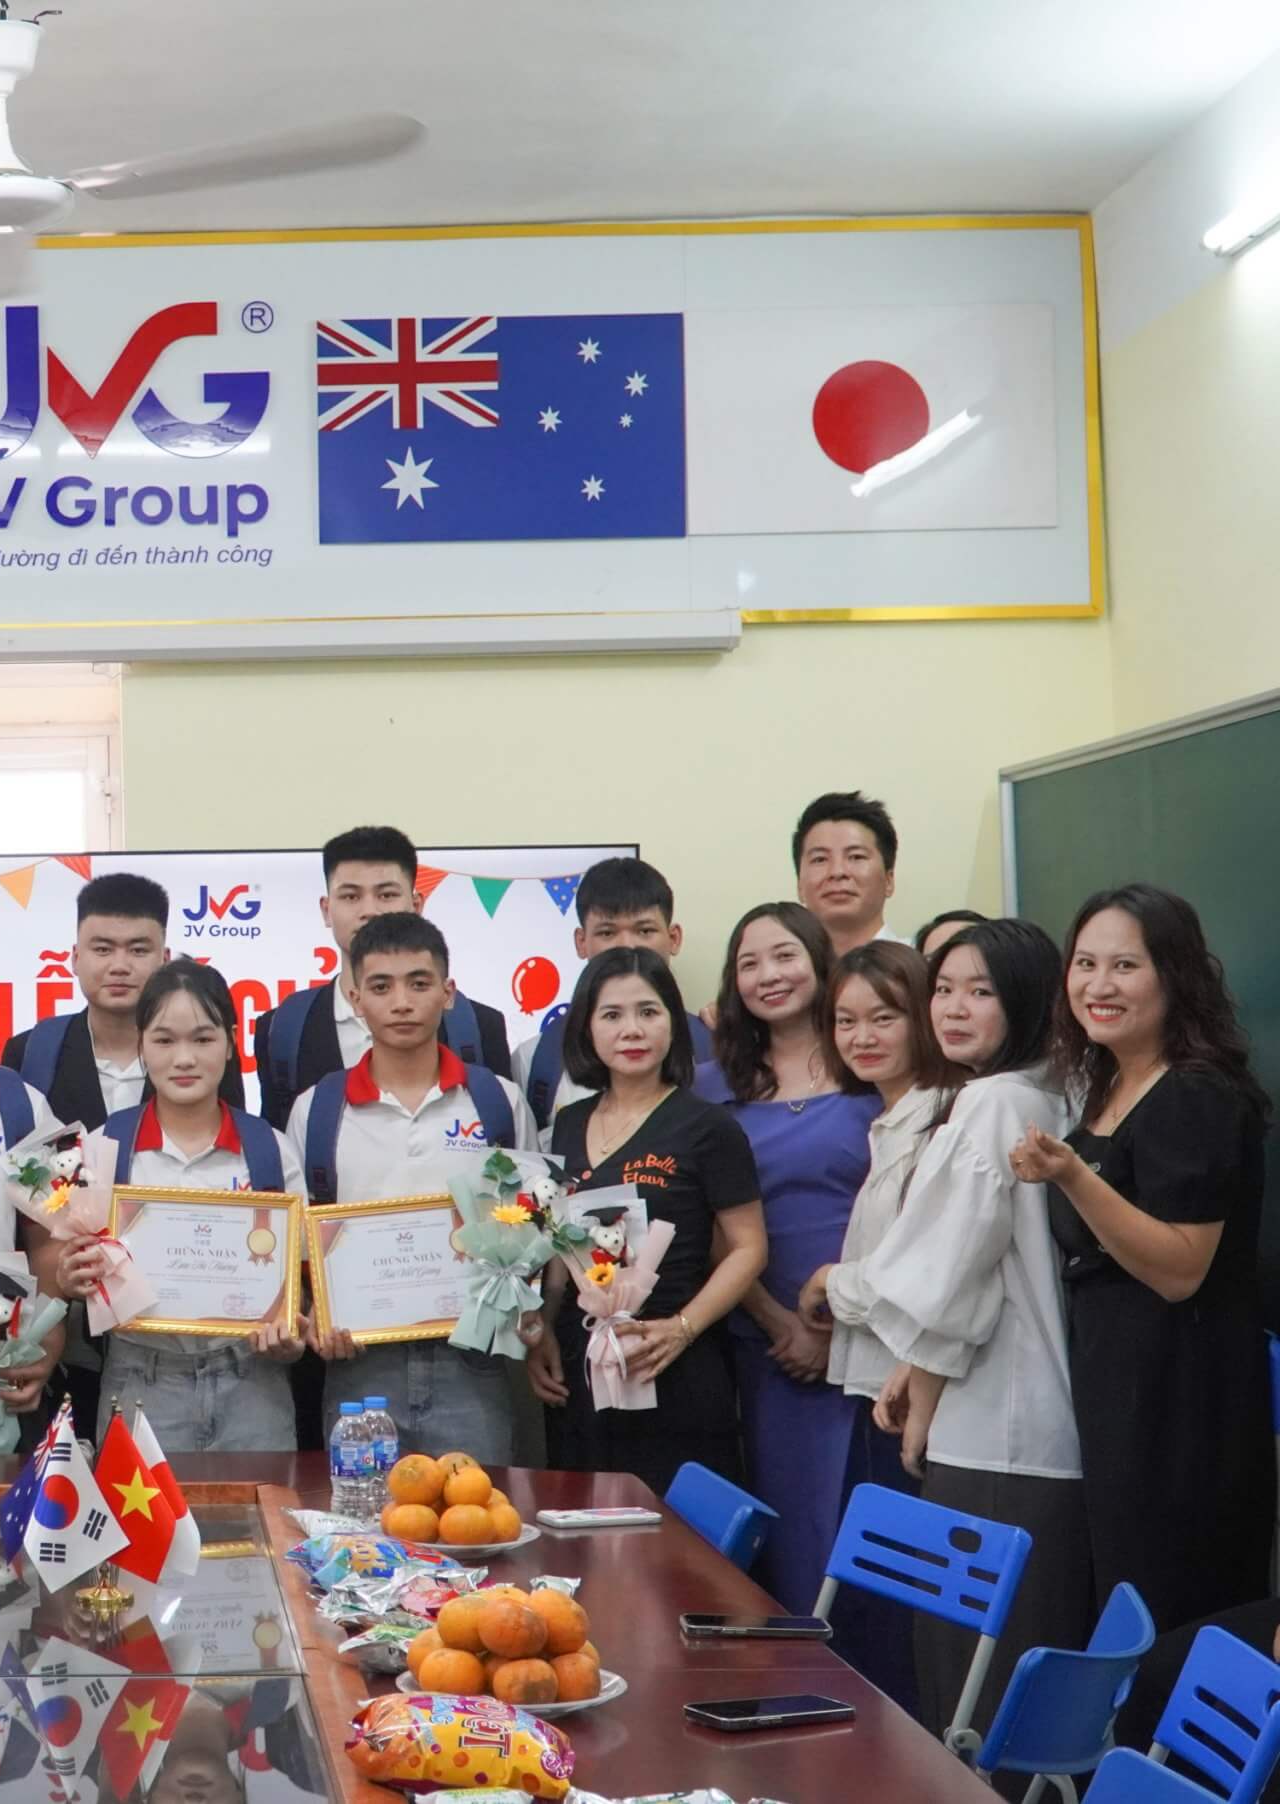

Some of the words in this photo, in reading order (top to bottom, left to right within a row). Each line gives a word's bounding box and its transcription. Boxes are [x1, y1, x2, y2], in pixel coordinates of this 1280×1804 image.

[45, 475, 270, 538] Group
[67, 547, 88, 566] đi
[95, 543, 140, 566] đến
[145, 546, 209, 565] thành
[216, 545, 274, 568] công
[182, 884, 261, 921] JVG
[183, 925, 205, 938] JV
[208, 924, 261, 940] Group
